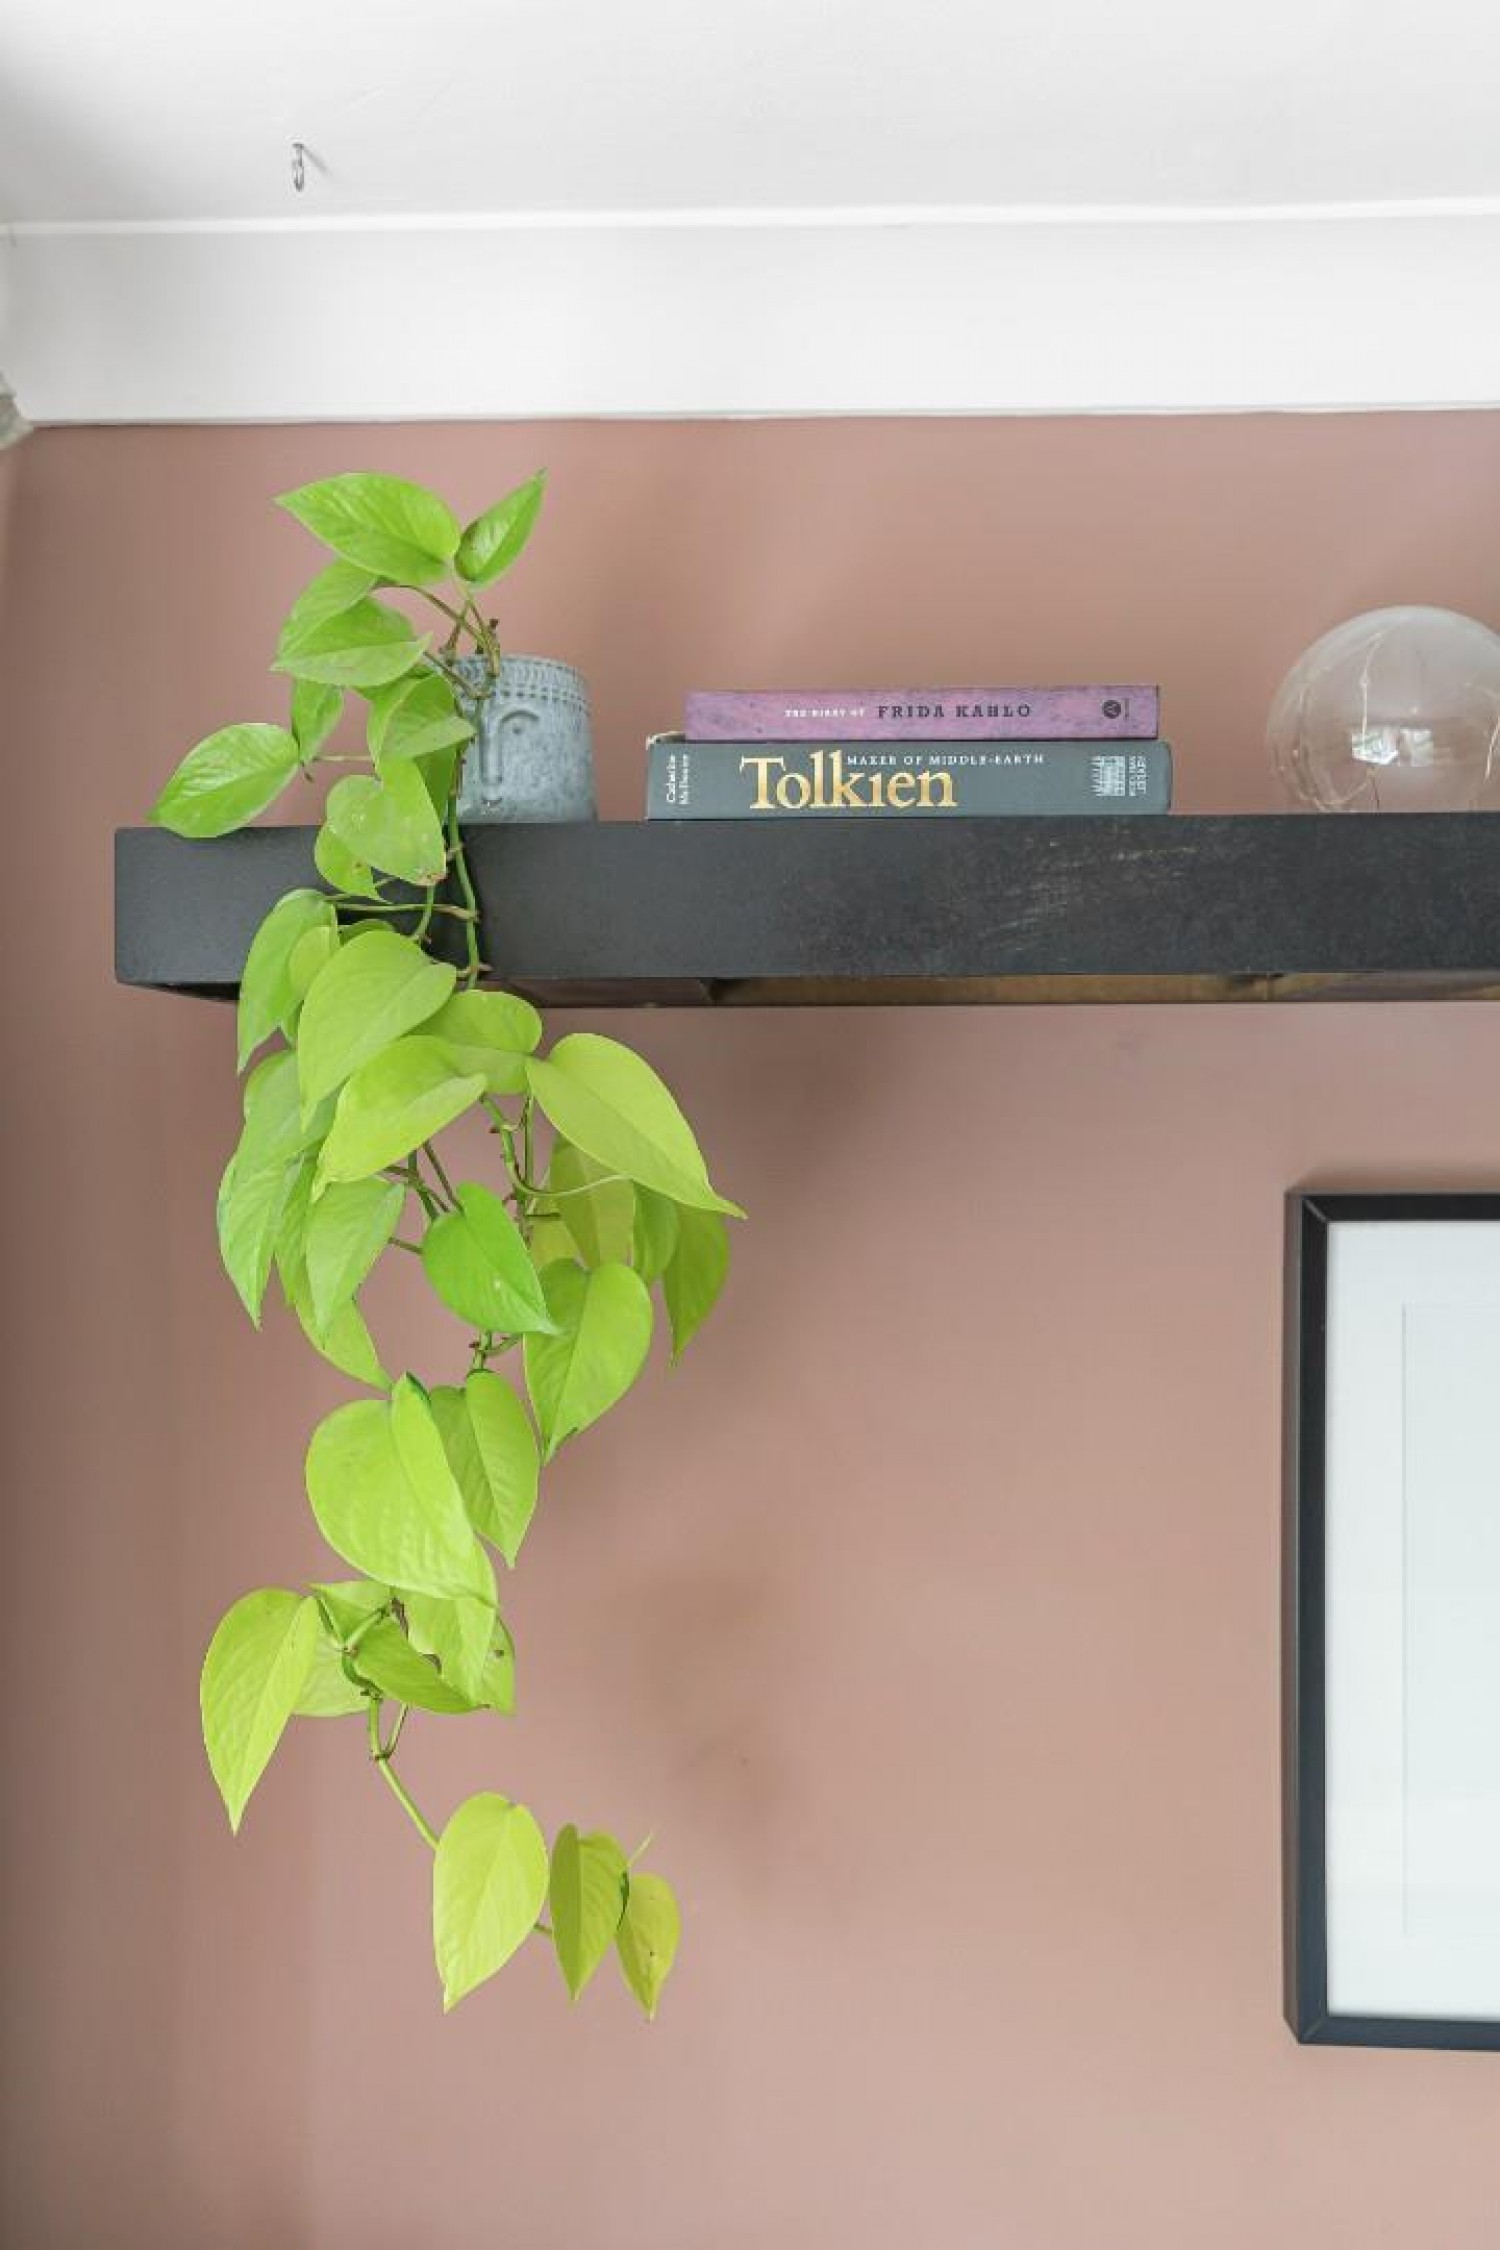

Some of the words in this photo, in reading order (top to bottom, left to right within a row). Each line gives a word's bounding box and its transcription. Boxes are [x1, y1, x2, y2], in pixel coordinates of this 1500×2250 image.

[878, 705, 945, 719] FRIDA
[955, 704, 1032, 718] KAHLO
[846, 755, 897, 767] MAKER
[903, 755, 923, 766] OF
[929, 754, 1045, 767] MIDDLE-EARTH
[739, 749, 959, 809] Tolkien
